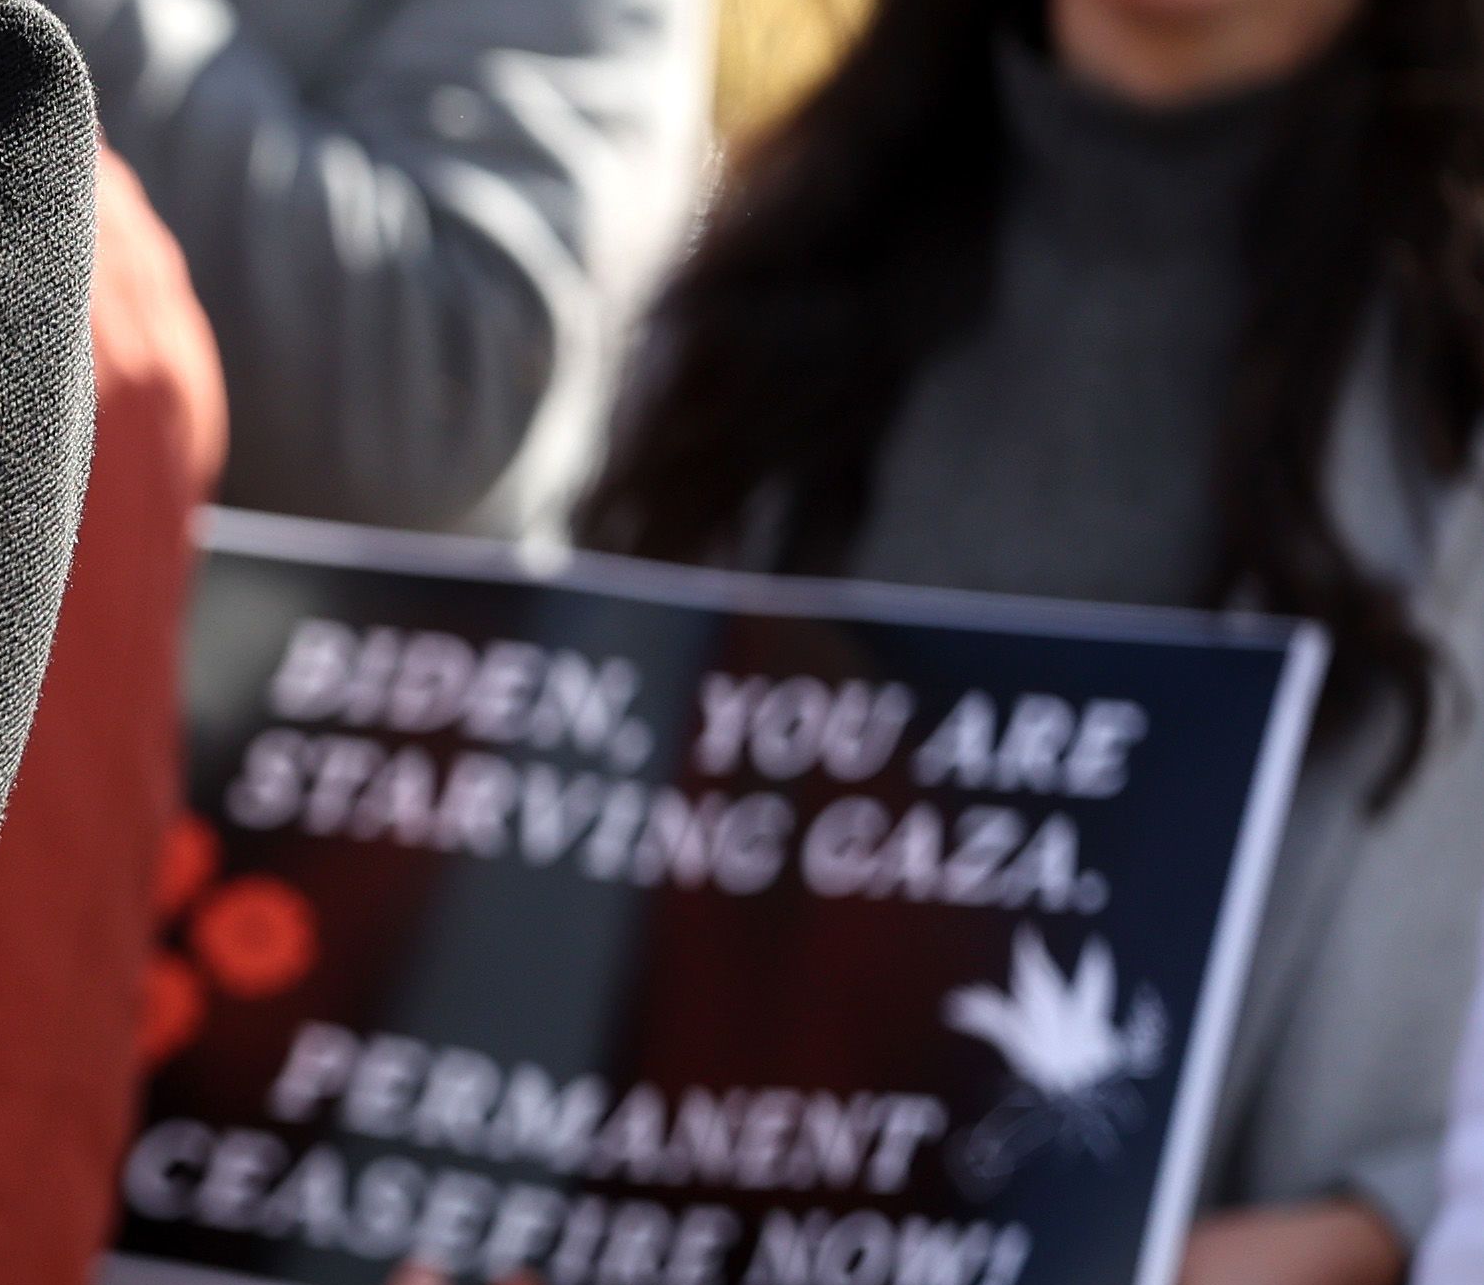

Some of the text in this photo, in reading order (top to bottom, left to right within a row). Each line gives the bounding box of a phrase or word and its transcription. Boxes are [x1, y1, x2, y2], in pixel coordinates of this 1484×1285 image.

[270, 620, 1143, 796] BIDEN, YOU ARE
[226, 730, 1107, 912] STARVING GAZA.
[270, 1024, 943, 1195] PERMANENT
